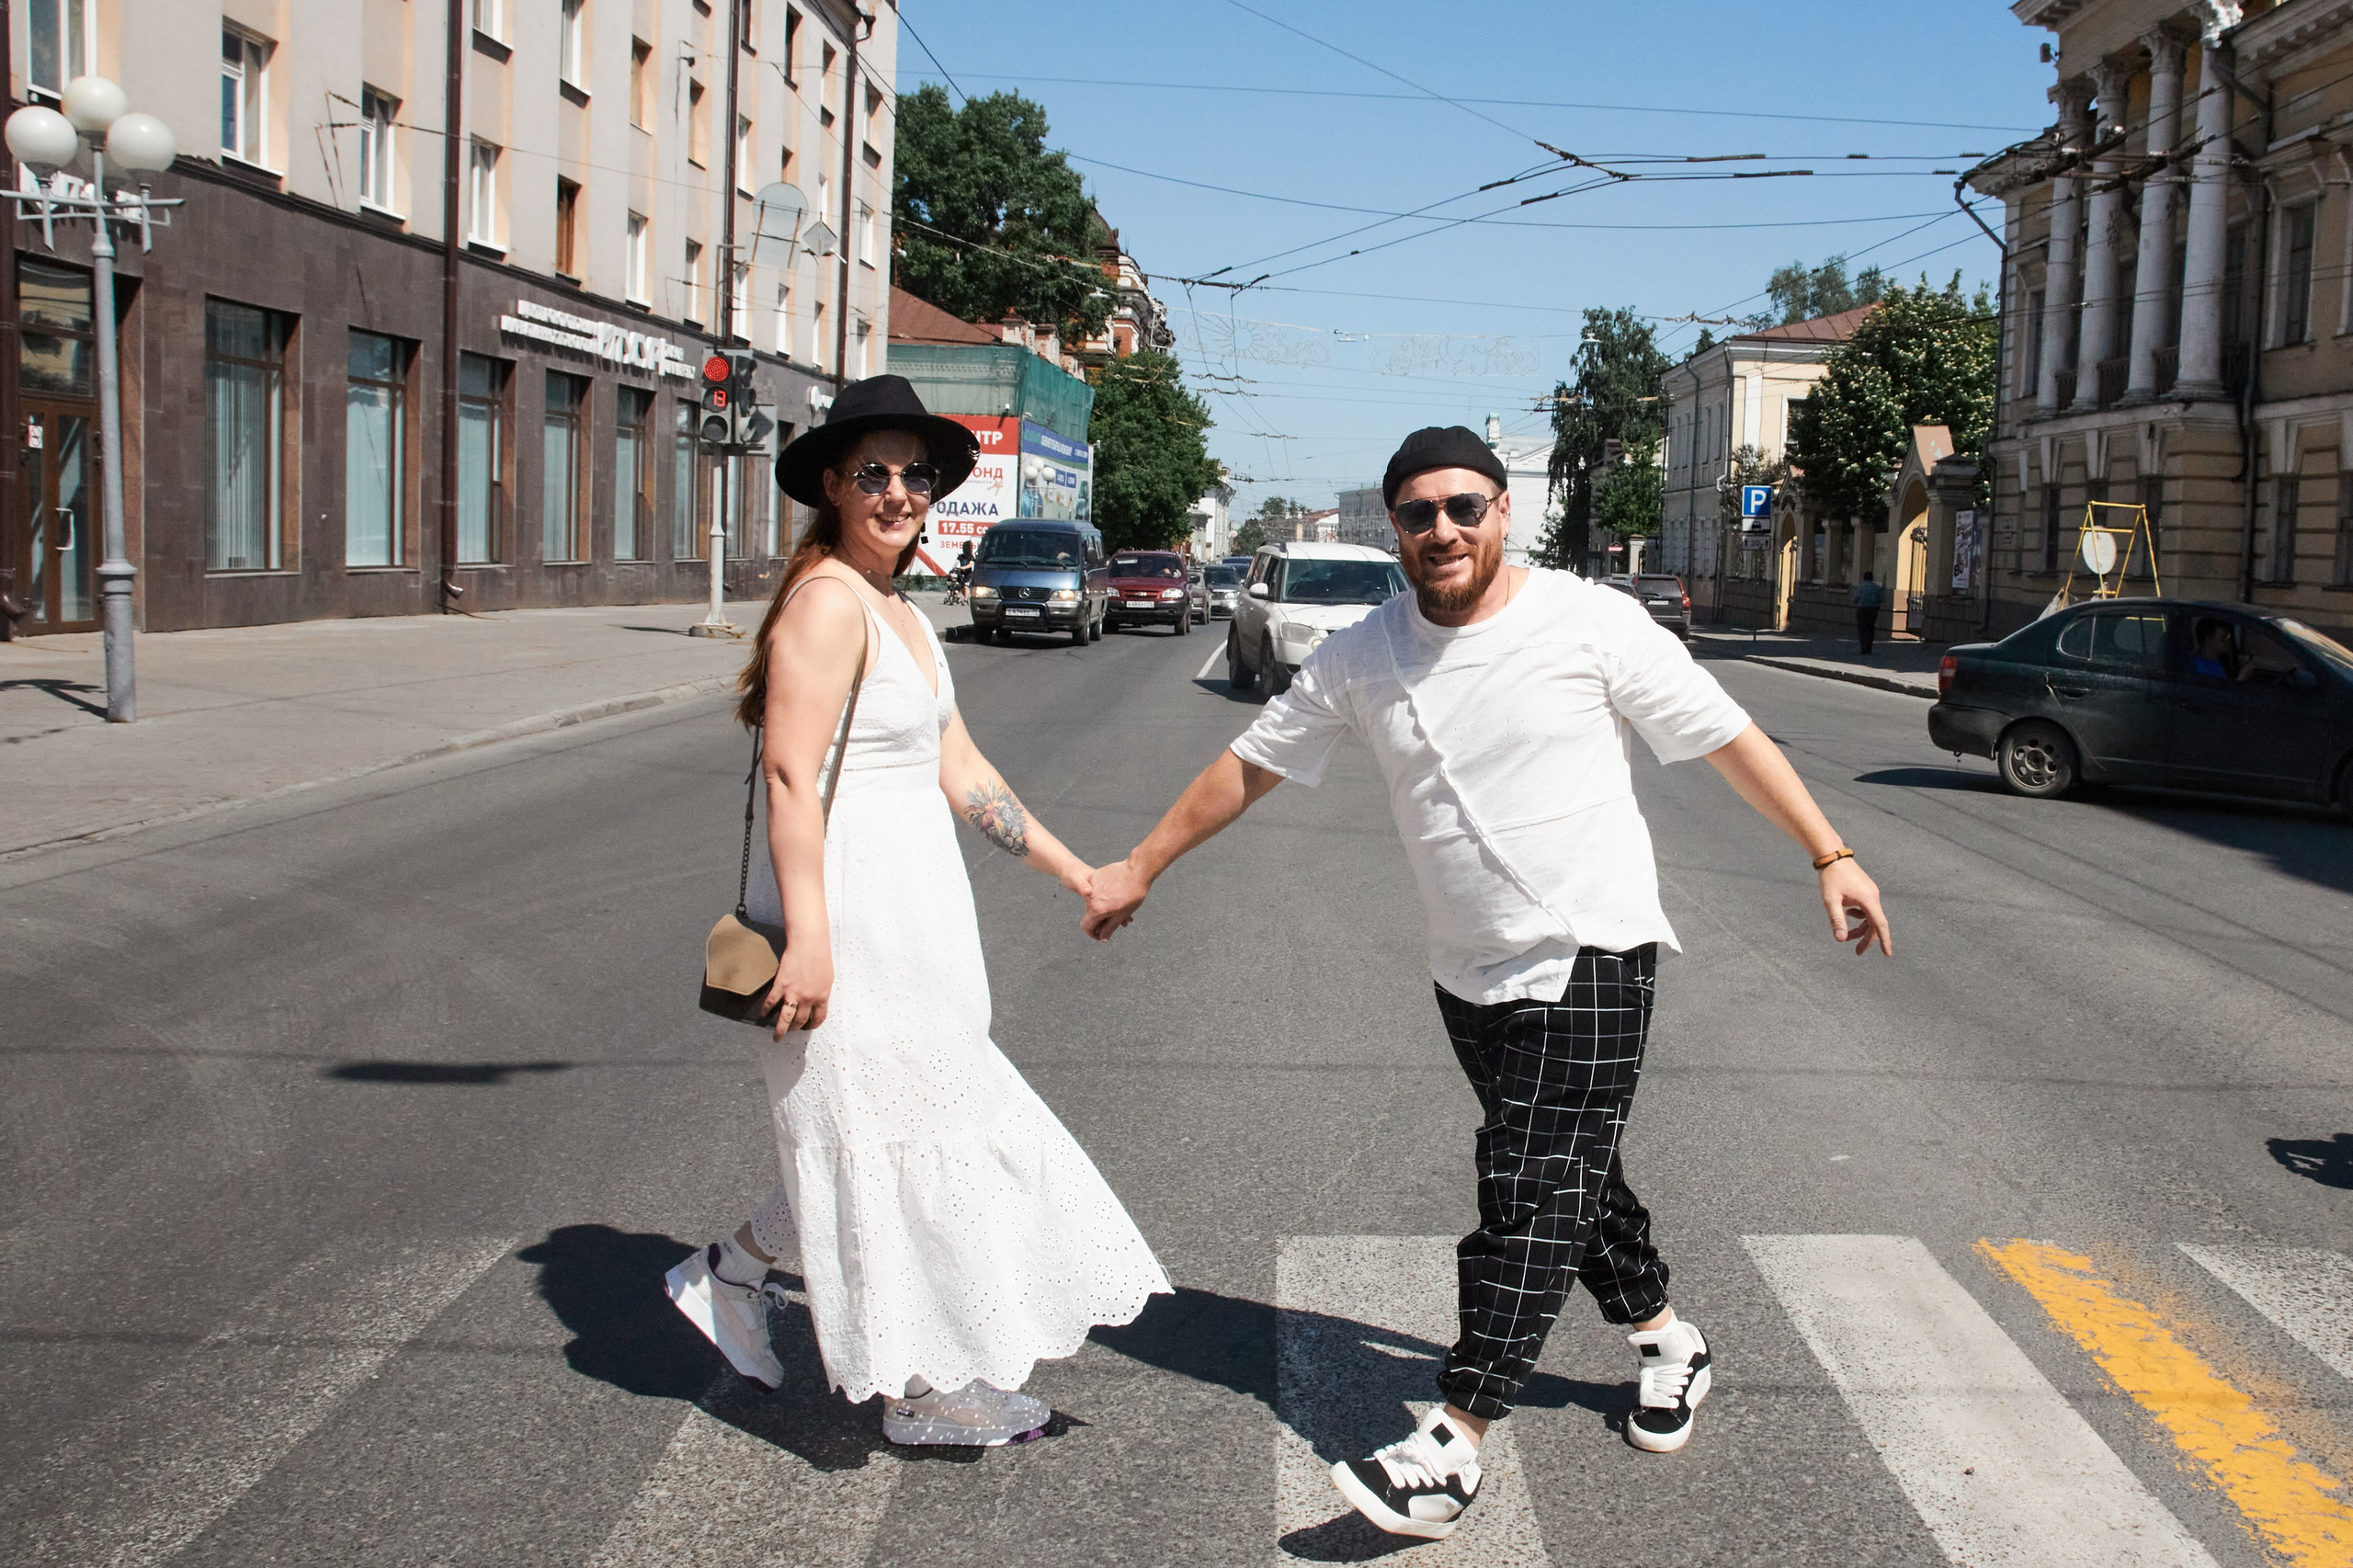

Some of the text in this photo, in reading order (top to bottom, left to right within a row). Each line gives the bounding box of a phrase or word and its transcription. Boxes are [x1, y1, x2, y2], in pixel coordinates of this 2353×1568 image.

[971, 429, 1004, 446] НТР
[972, 467, 1003, 481] ОНД
[929, 501, 999, 517] ОДАЖА
[1750, 489, 1767, 514] P
[941, 522, 989, 535] 17.55 со
[939, 540, 980, 549] ЗЕМЕЬ
